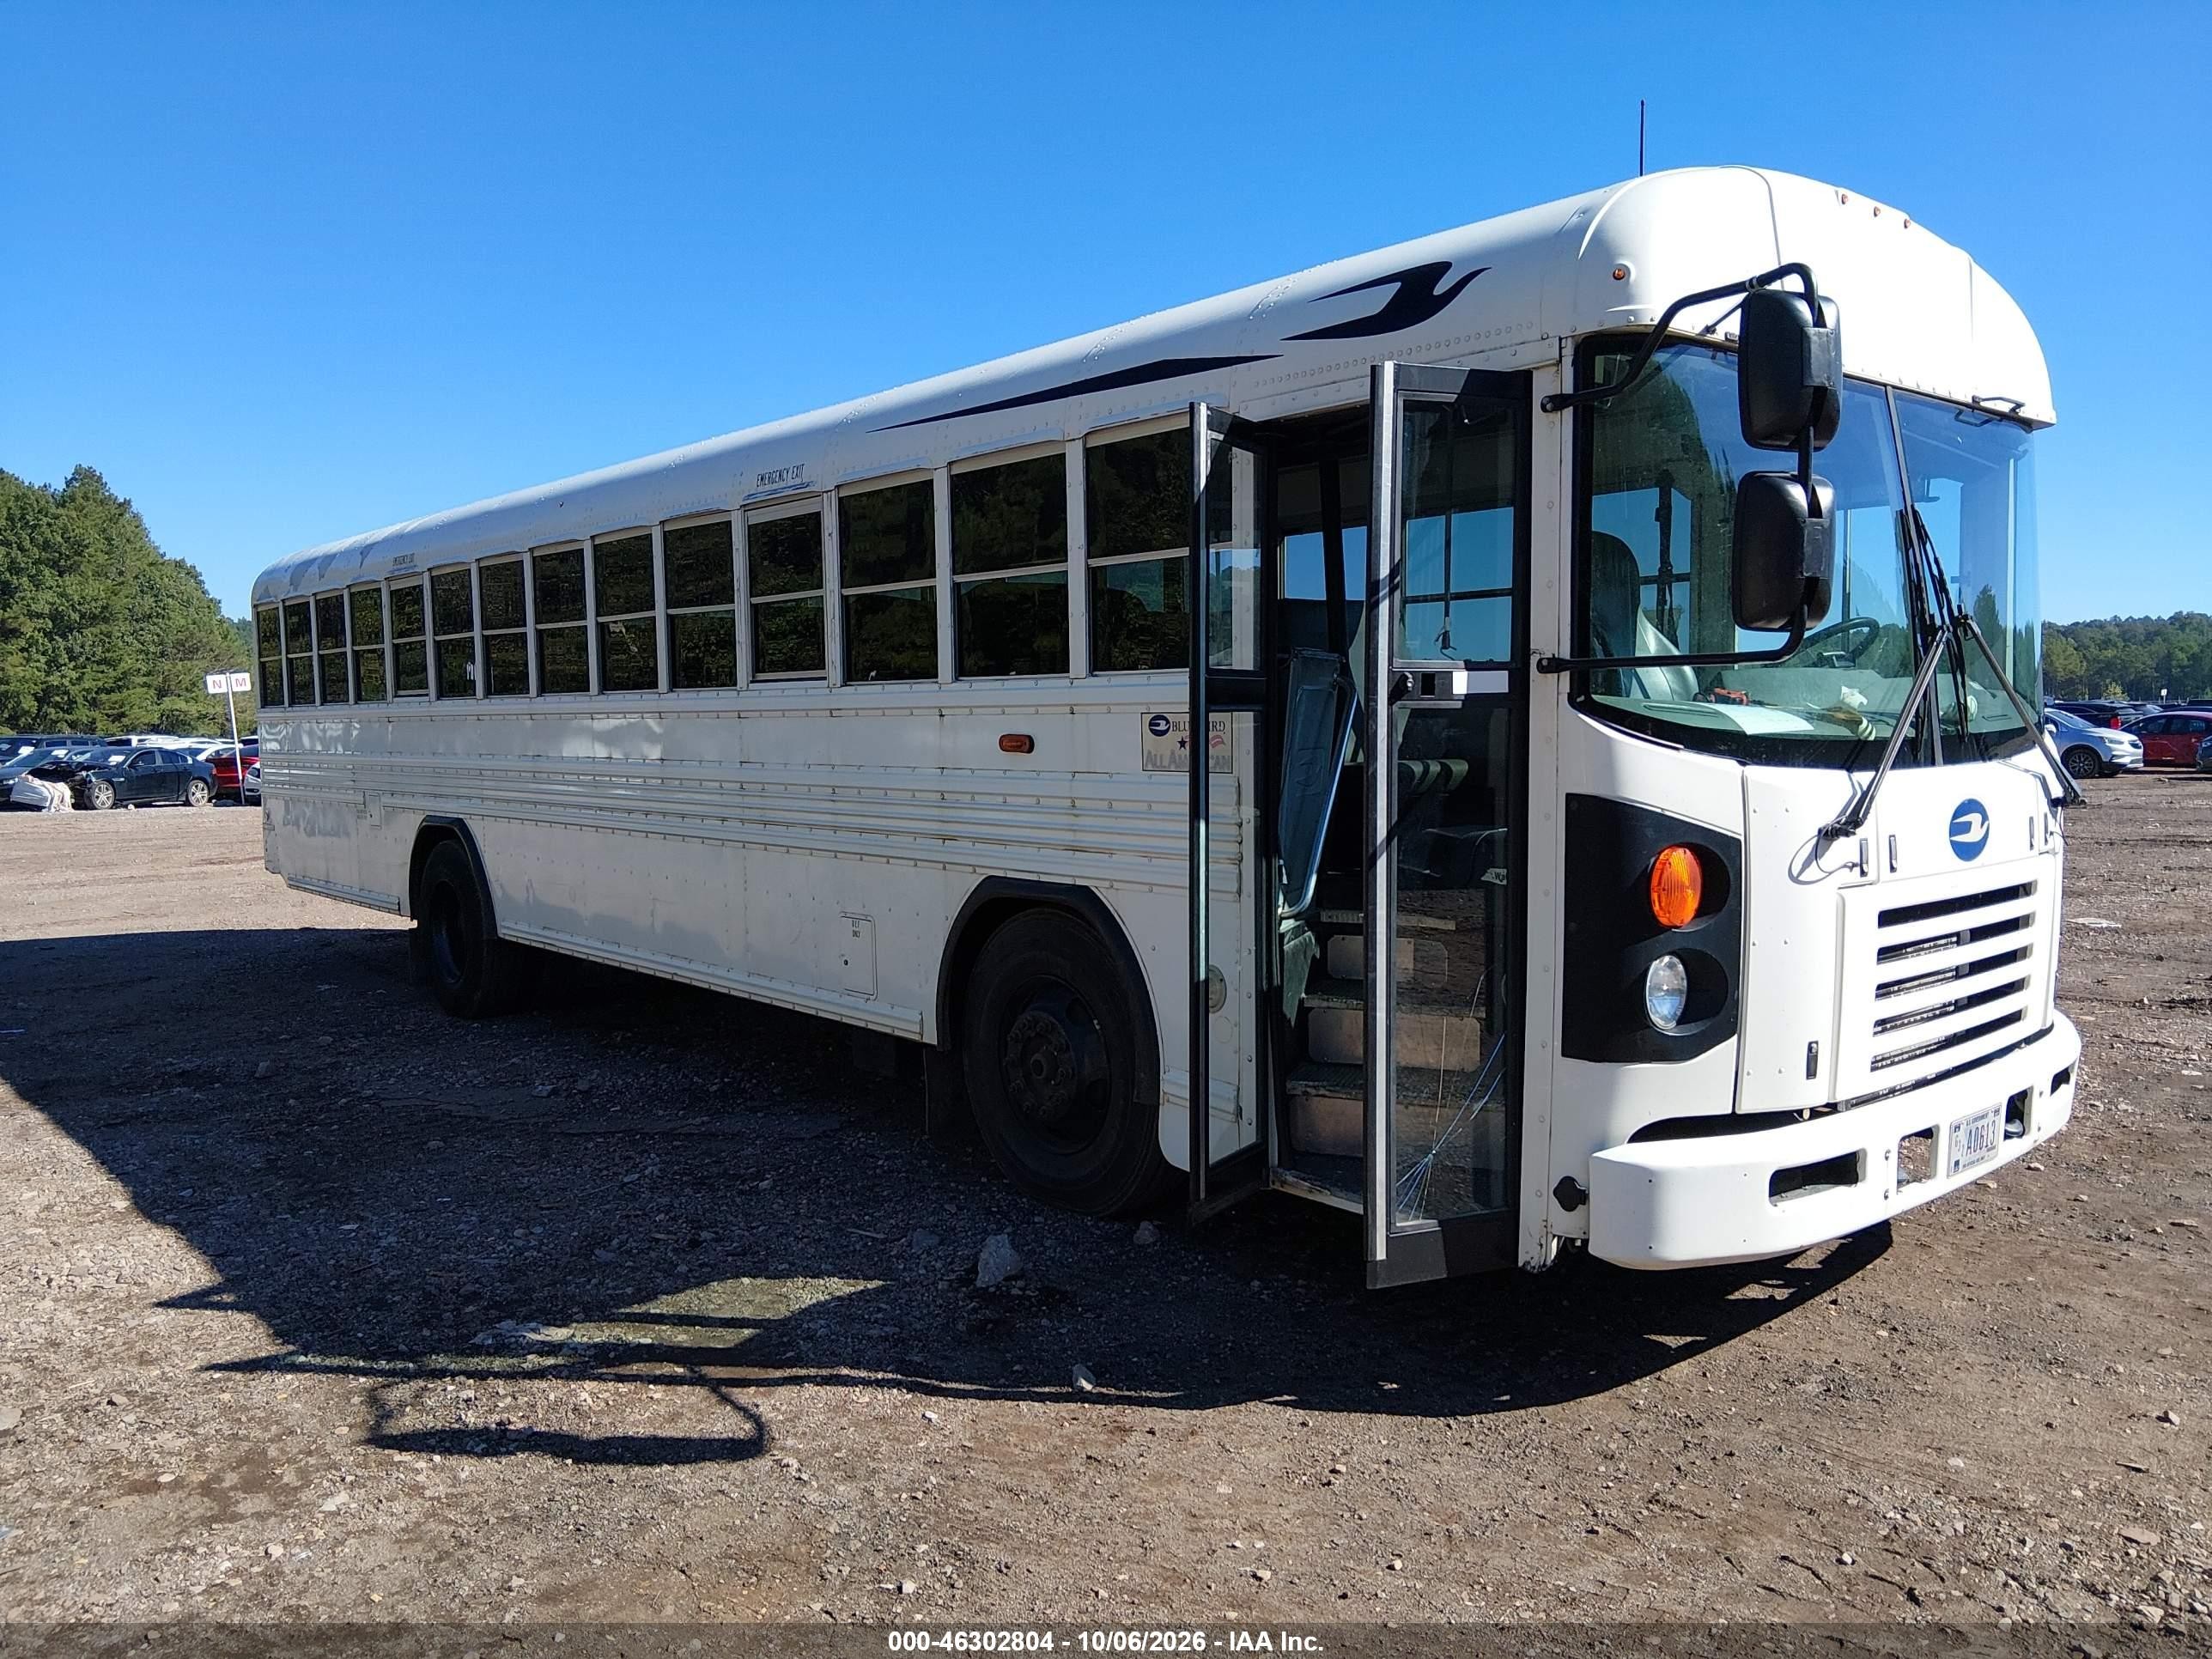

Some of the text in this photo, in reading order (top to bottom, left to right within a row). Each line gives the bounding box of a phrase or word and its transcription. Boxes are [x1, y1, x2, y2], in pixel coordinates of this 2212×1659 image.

[757, 464, 805, 488] EMERGENCY EXIT
[212, 679, 222, 689] N
[235, 678, 247, 687] M
[1171, 720, 1190, 732] BLU
[1145, 749, 1167, 769] ALL
[1966, 1119, 1996, 1157] A0613
